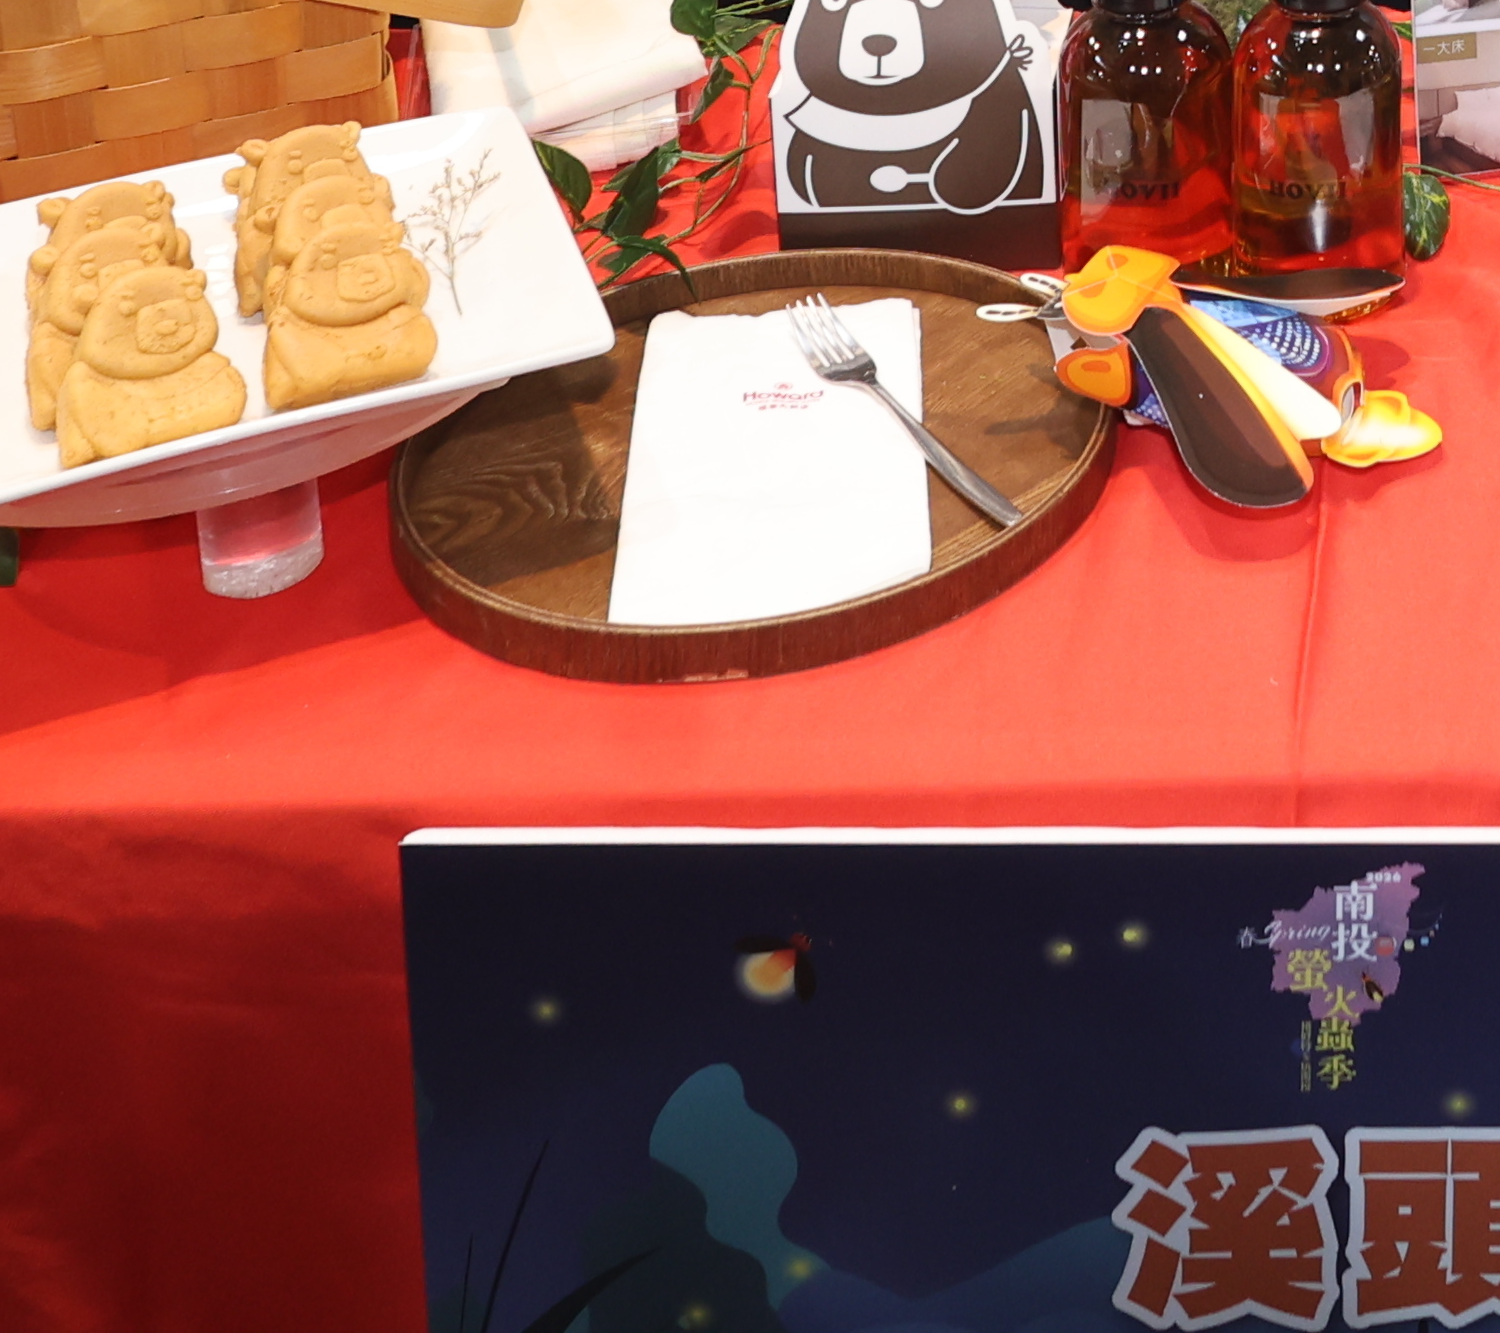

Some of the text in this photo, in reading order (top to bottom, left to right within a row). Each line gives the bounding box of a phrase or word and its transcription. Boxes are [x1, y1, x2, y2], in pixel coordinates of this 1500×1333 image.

[1423, 37, 1466, 56] 一大床
[742, 389, 824, 402] Howard
[1365, 871, 1402, 883] 2026
[1331, 880, 1378, 963] 南投
[1286, 947, 1361, 1091] 螢火蟲季
